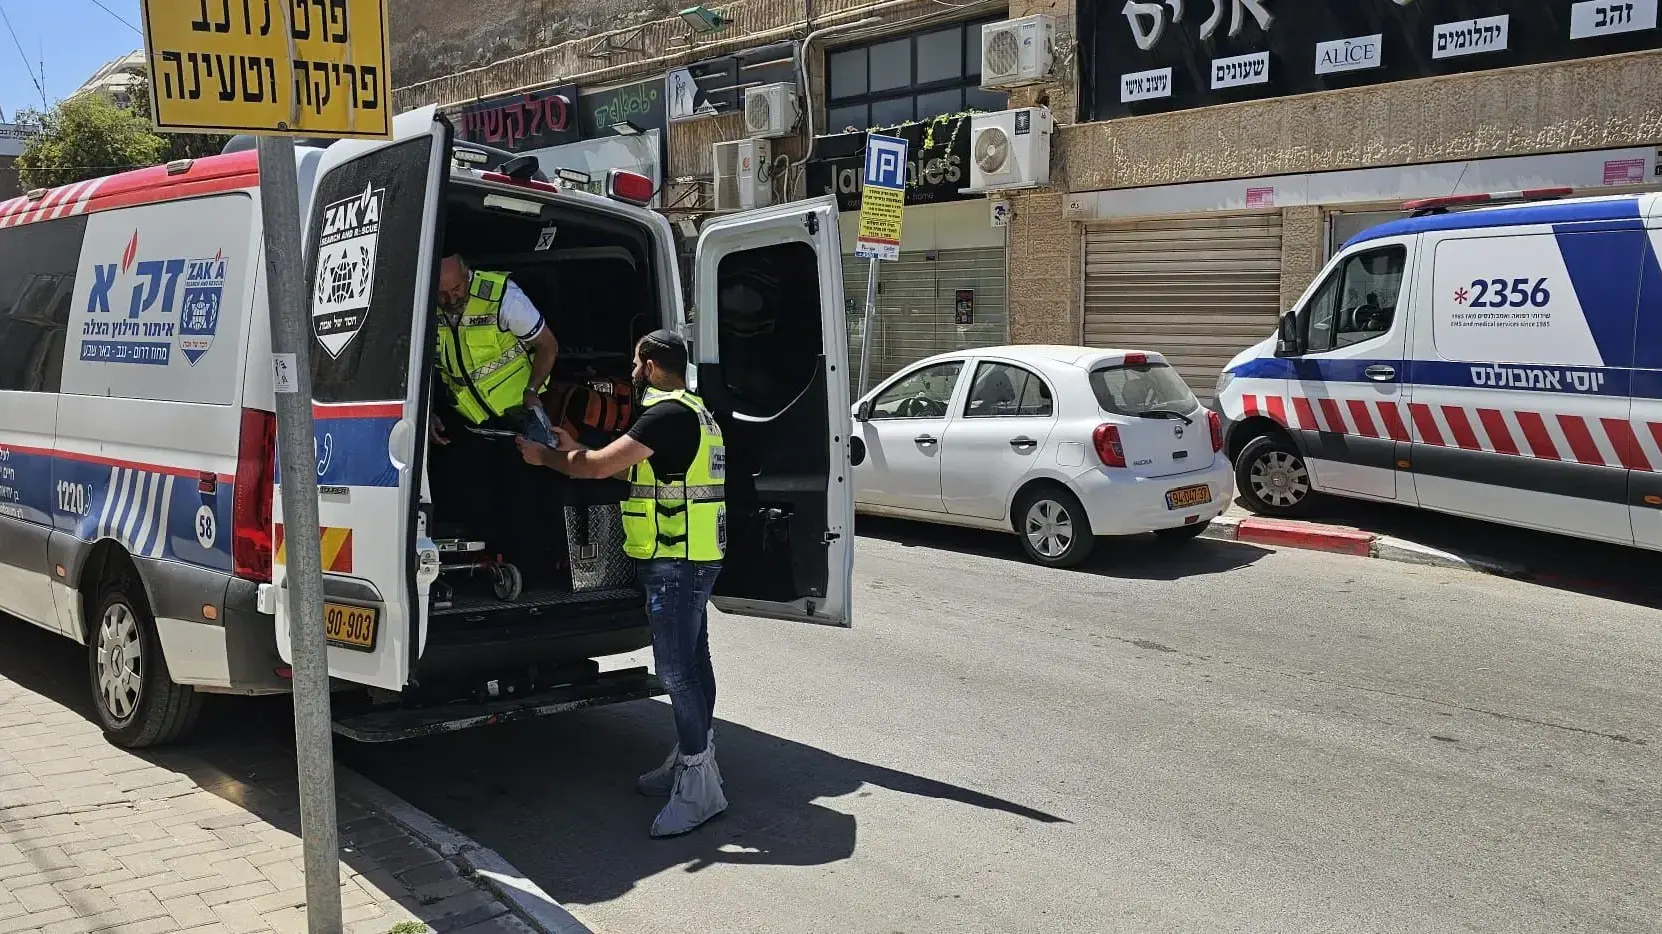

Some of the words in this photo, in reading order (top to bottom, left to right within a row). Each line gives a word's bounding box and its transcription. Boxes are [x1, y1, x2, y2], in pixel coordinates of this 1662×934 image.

[1594, 3, 1633, 27] זהב
[1437, 20, 1501, 51] יהלומים
[1320, 41, 1375, 65] ALICE
[162, 50, 277, 104] וטעינה
[1216, 59, 1265, 82] שעונים
[293, 60, 377, 115] פריקה
[1125, 79, 1144, 95] אישי
[1146, 74, 1168, 92] עיצוב
[83, 319, 109, 336] הצלה
[112, 319, 140, 338] חילוץ
[142, 322, 175, 337] איתור
[1471, 361, 1562, 390] אמבולנס
[1566, 370, 1605, 392] יוסי
[57, 480, 84, 514] 1220
[199, 514, 213, 539] 58
